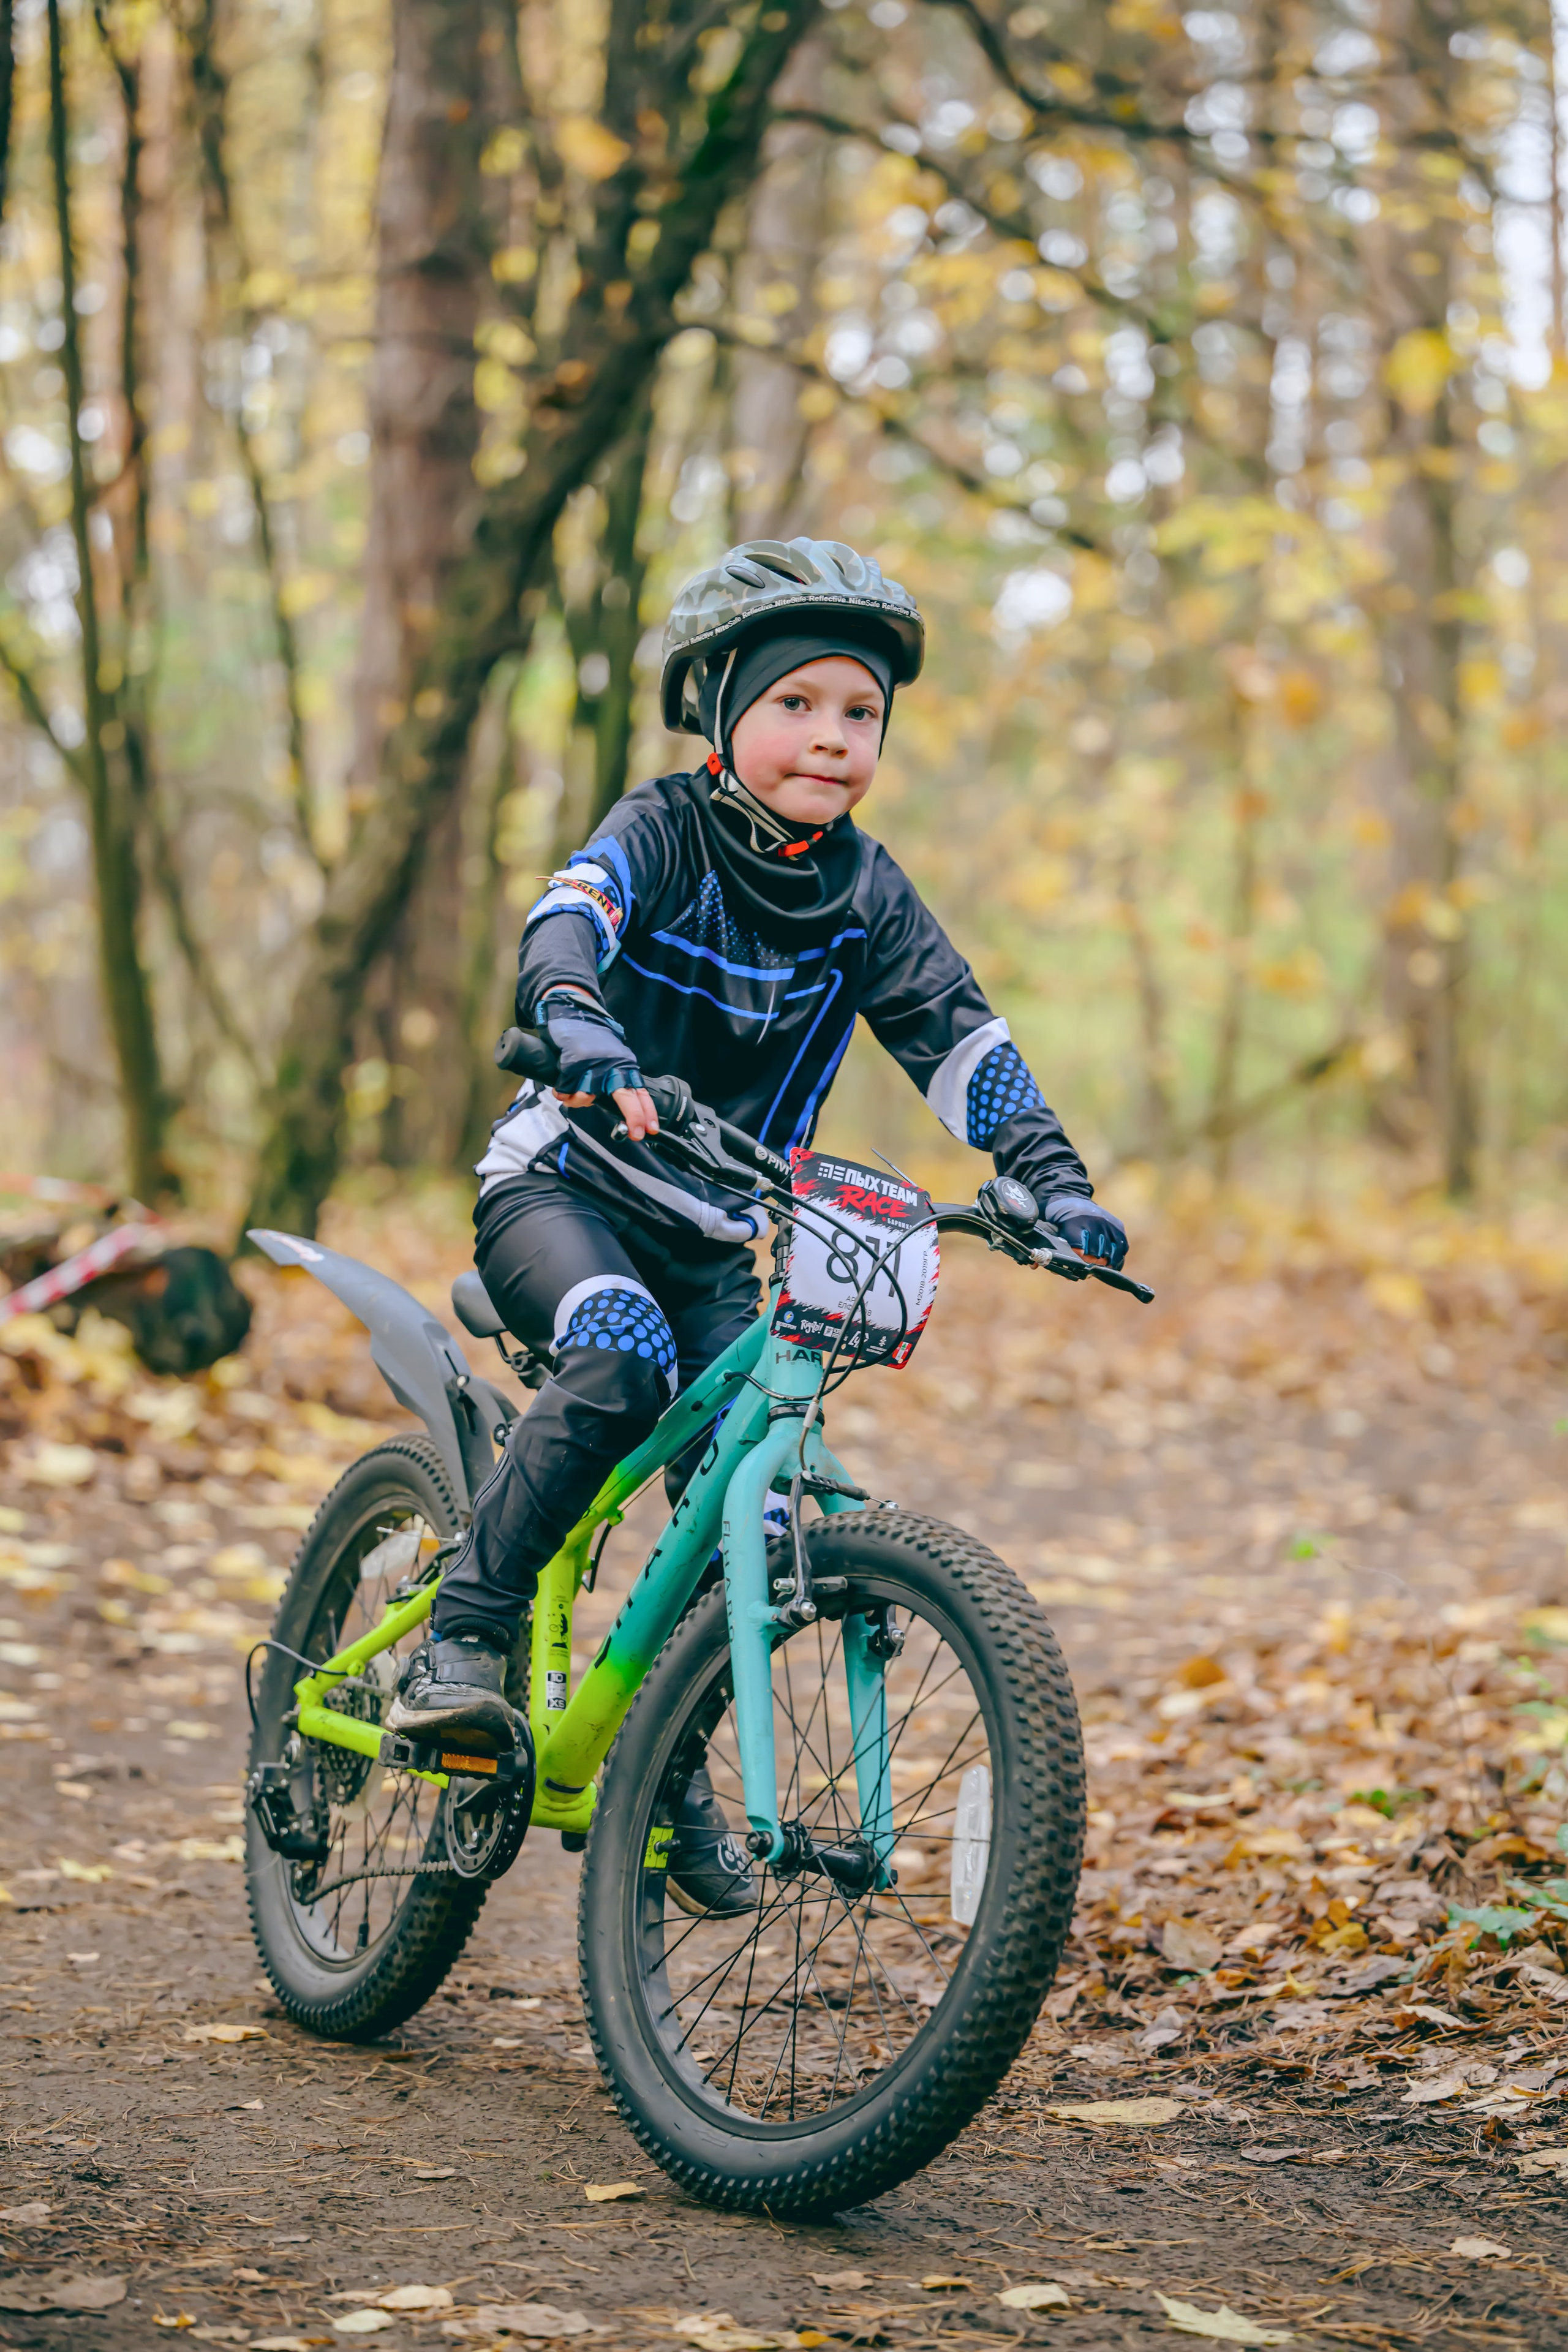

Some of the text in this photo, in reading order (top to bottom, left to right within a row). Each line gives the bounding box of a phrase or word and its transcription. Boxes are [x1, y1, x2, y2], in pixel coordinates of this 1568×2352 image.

[742, 603, 774, 619] Reflective
[774, 595, 807, 608] NiteSafe
[808, 595, 846, 603] Reflective
[848, 597, 881, 608] NiteSafe
[832, 1185, 912, 1218] RACE
[881, 1180, 918, 1207] TEAM
[549, 1698, 565, 1708] XS
